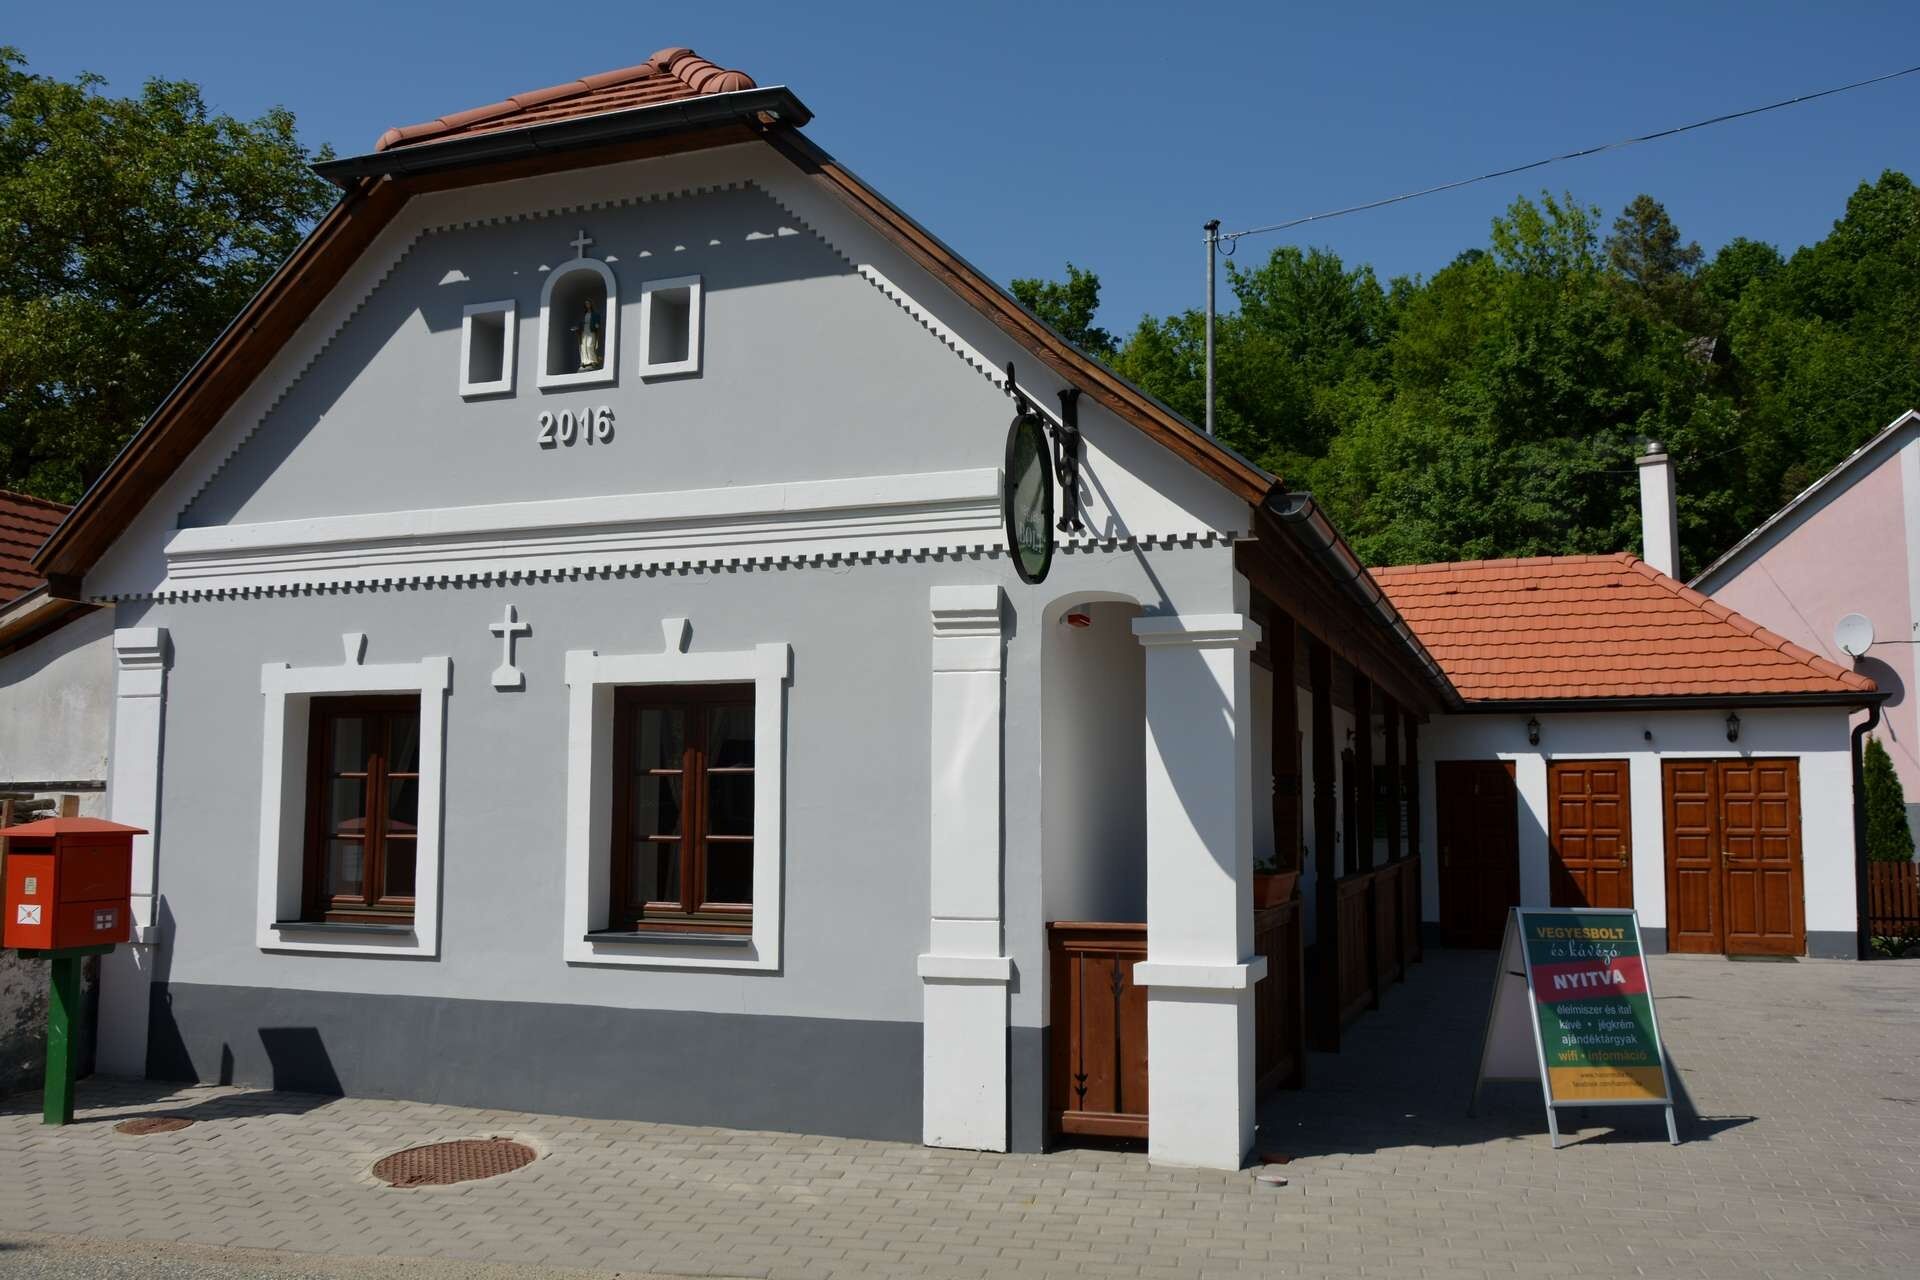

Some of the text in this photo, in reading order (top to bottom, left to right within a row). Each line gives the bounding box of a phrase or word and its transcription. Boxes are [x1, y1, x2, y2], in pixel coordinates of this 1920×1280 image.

[536, 405, 612, 444] 2016
[1537, 928, 1625, 939] VEGYESBOLT
[1551, 938, 1619, 966] és kávézó
[1553, 969, 1626, 990] NYITVA
[1557, 1004, 1602, 1014] élelmiszer
[1605, 1004, 1616, 1014] és
[1559, 1019, 1635, 1032] kávé jégkrém
[1561, 1033, 1639, 1046] ajándéktárgyak
[1558, 1049, 1648, 1061] wifi információ
